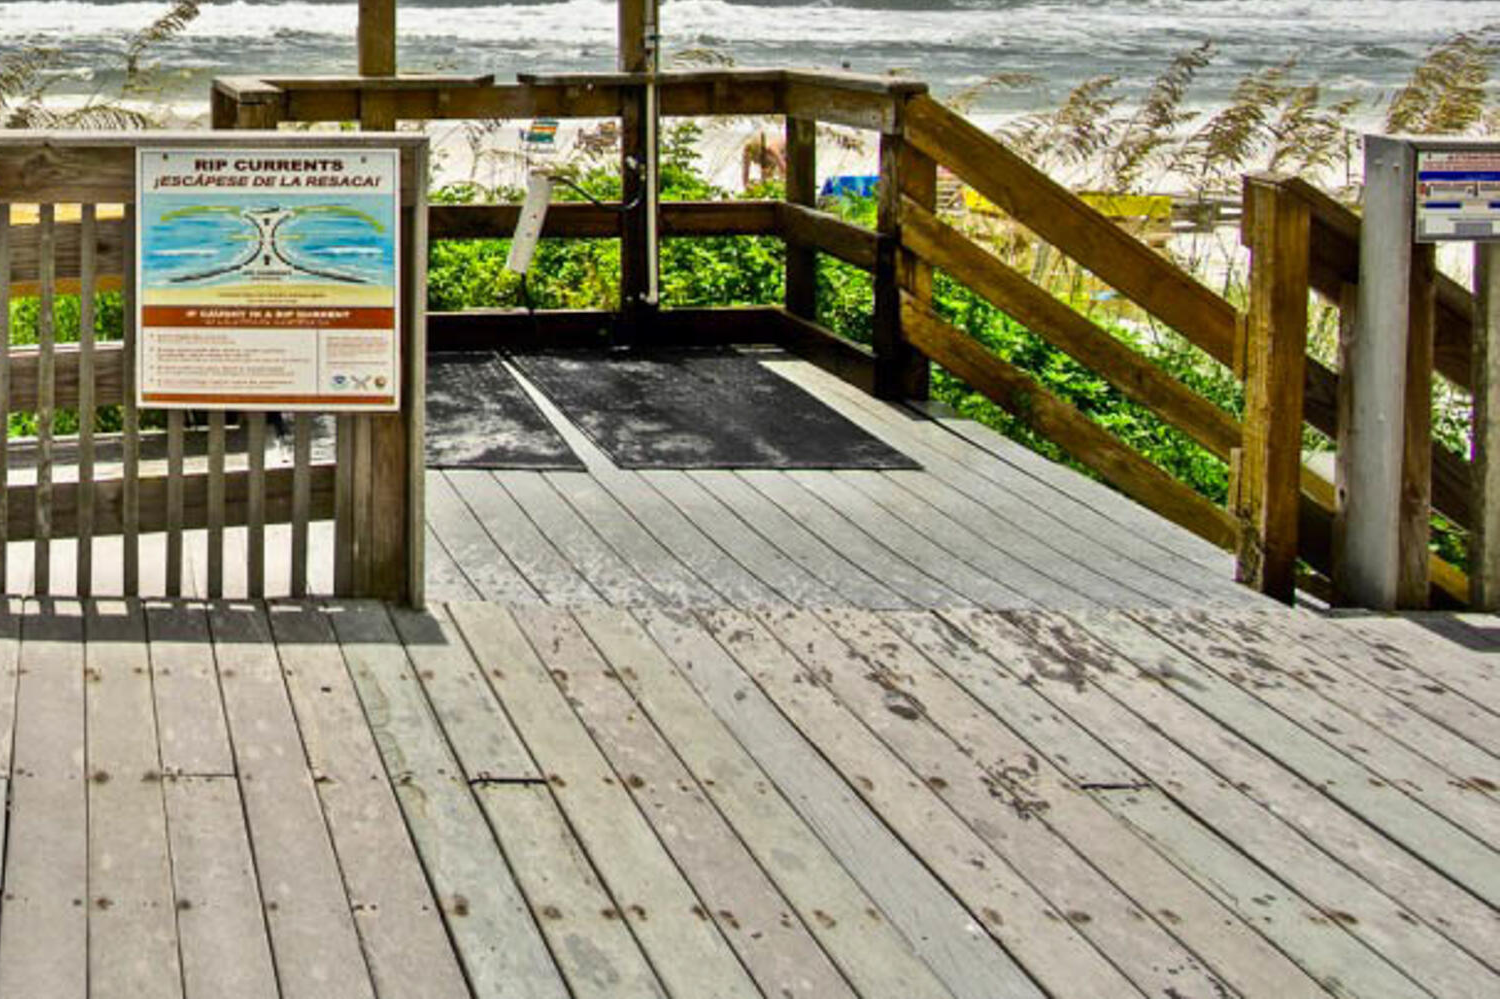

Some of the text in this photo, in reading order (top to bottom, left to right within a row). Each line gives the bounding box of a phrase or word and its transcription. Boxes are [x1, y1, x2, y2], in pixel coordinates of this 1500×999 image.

[194, 159, 344, 171] RIP CURRENTS
[252, 176, 276, 187] DE
[280, 176, 304, 187] LA
